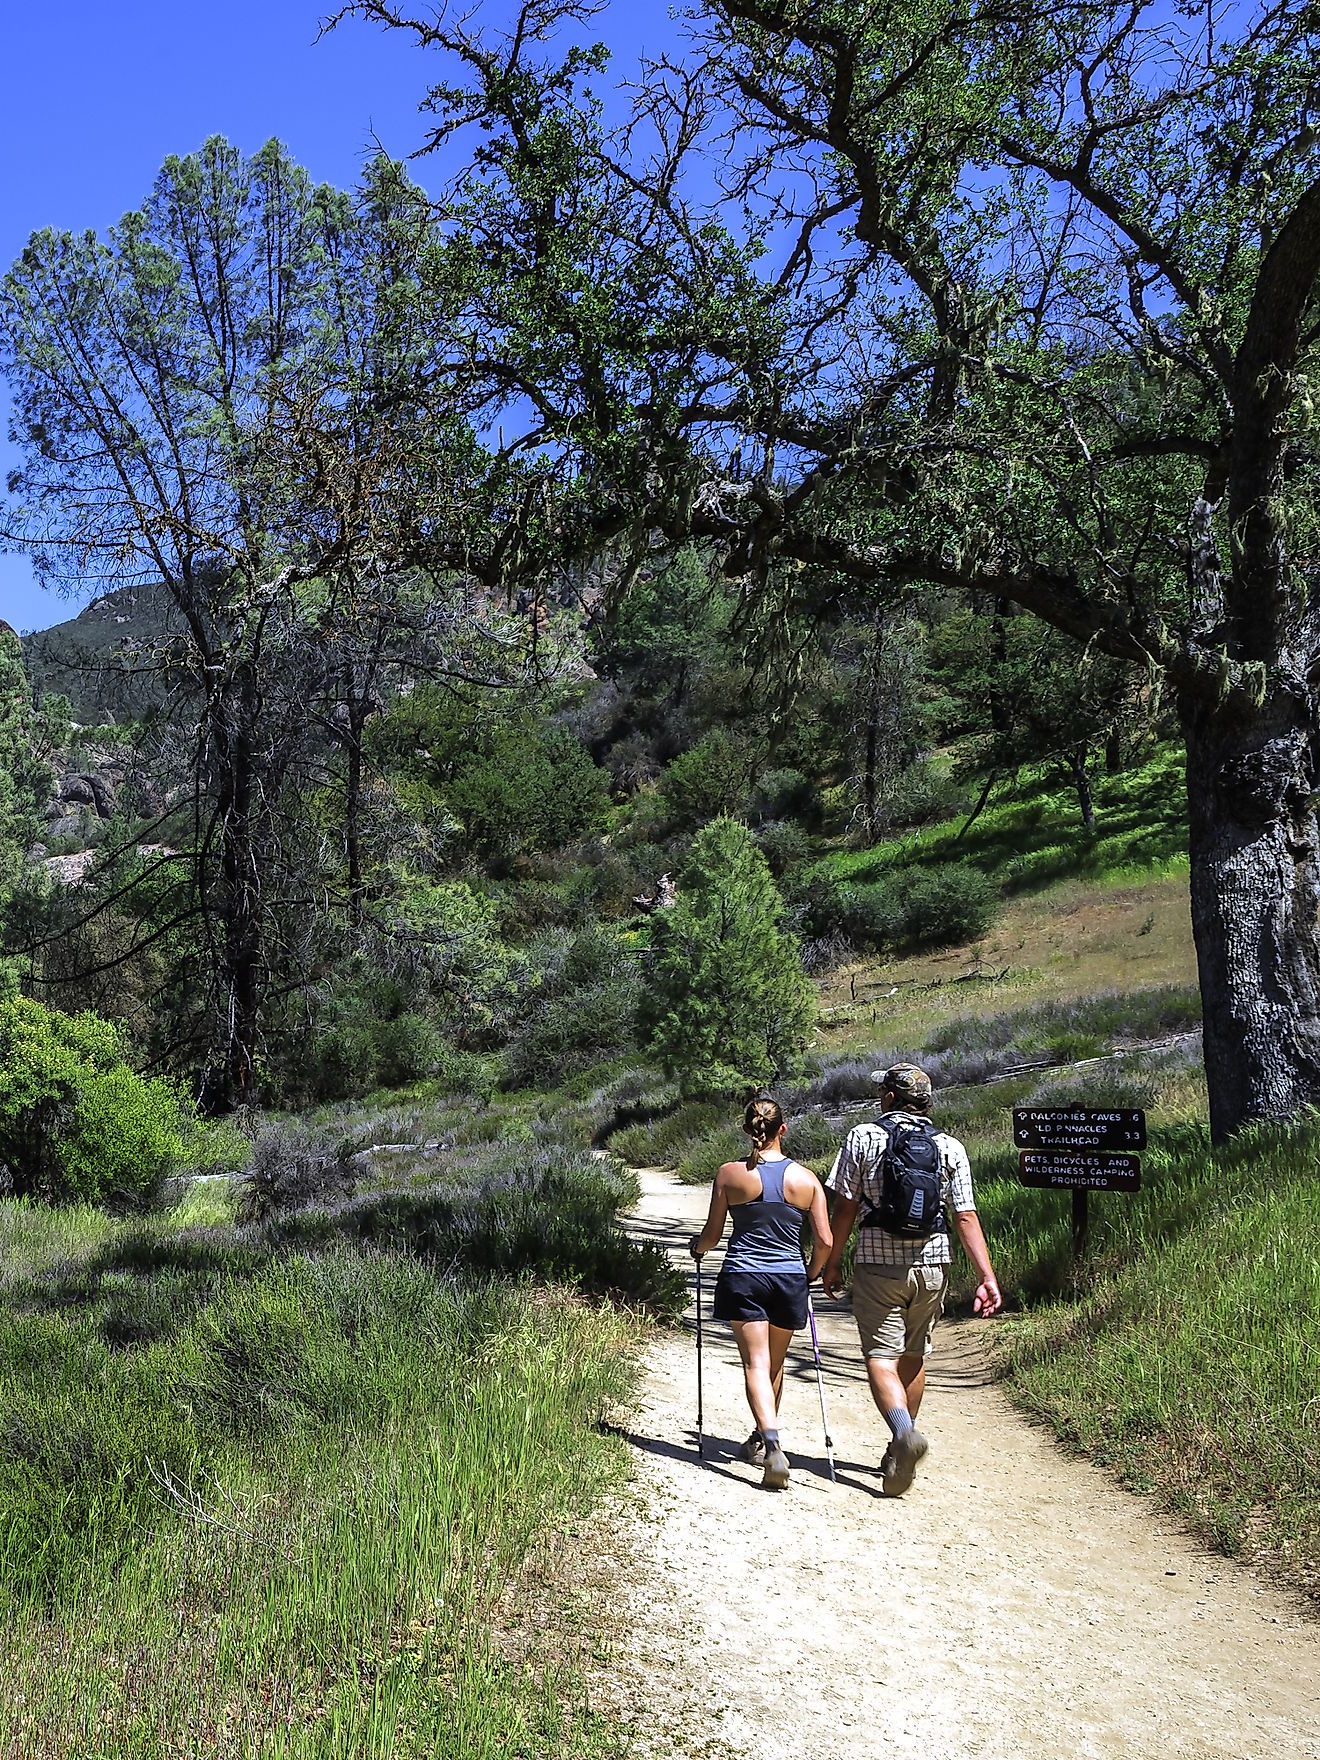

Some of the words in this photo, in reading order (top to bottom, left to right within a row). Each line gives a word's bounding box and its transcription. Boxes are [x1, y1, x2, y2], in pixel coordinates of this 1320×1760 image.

[1056, 1125, 1107, 1133] PNNACLES
[1053, 1157, 1100, 1166] BICYCLES
[1025, 1166, 1085, 1175] WILDERNESS
[1090, 1168, 1135, 1177] CAMPING
[1051, 1177, 1108, 1186] PROHIBITED
